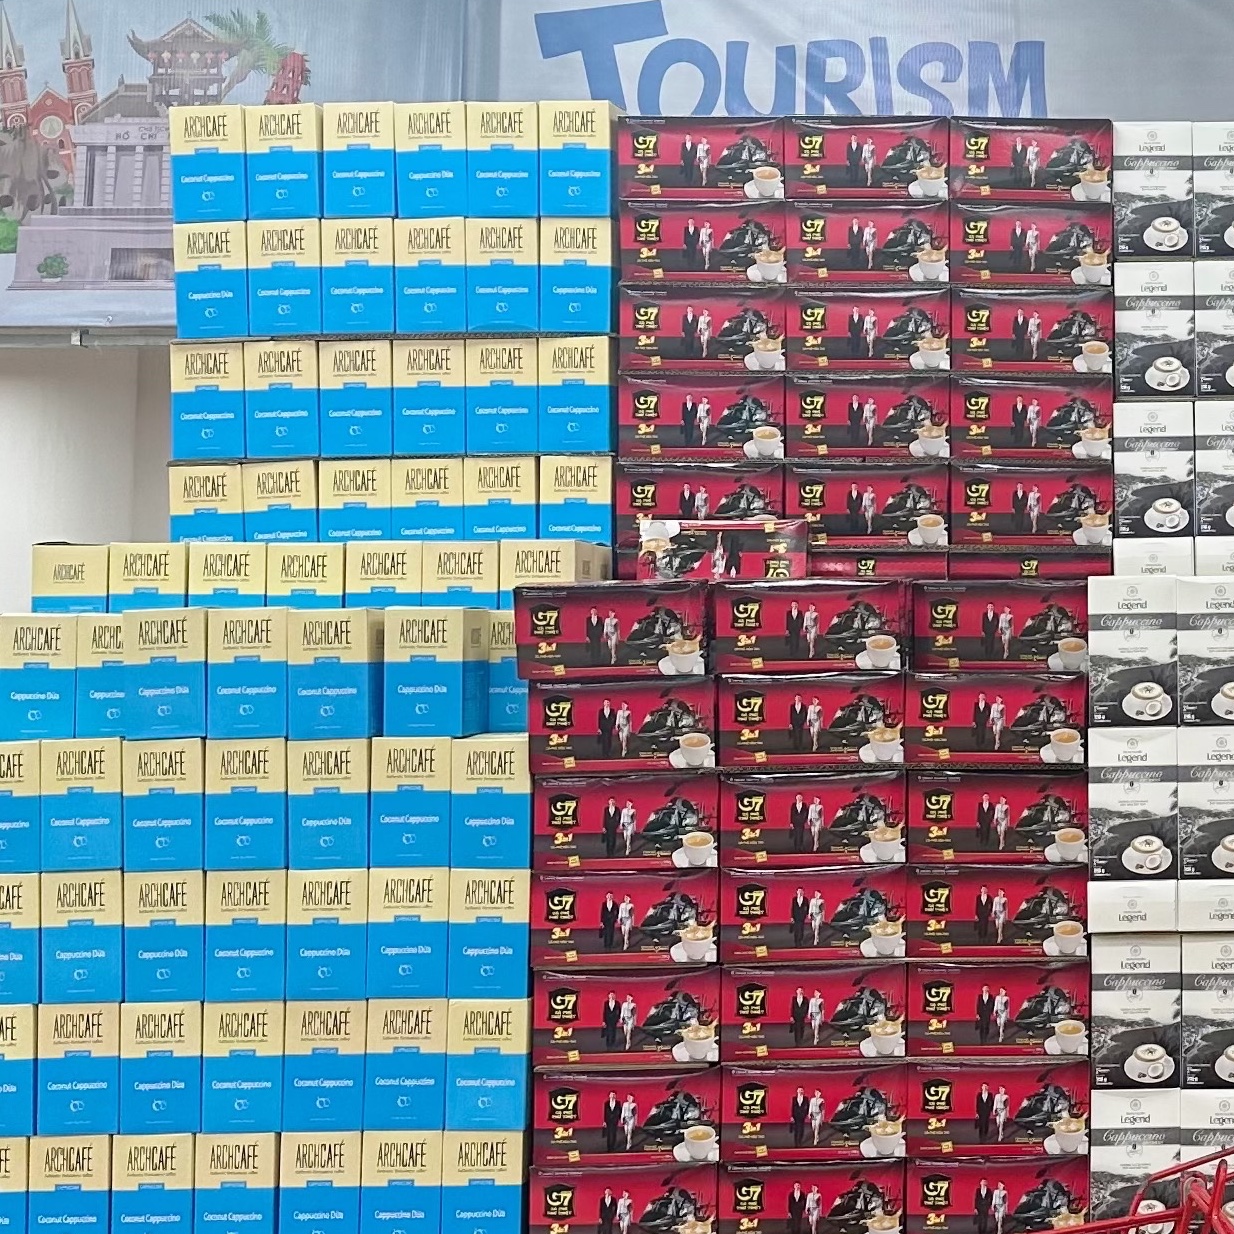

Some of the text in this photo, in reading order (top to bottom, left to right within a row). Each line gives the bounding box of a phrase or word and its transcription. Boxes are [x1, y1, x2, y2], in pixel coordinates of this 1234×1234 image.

[534, 1, 1045, 117] TOURISM
[183, 112, 229, 138] ARCHCAFÉ
[633, 134, 657, 149] G7
[800, 135, 822, 149] G7
[407, 224, 453, 250] ARCHCAFÉ
[965, 220, 987, 234] G7
[186, 228, 232, 254] ARCHCAFÉ
[802, 307, 824, 321] G7
[184, 349, 230, 375] ARCHCAFÉ
[634, 394, 658, 409] G7
[256, 468, 302, 494] ARCHCAFÉ
[477, 463, 523, 489] ARCHCAFÉ
[966, 482, 990, 497] G7
[123, 550, 171, 578] ARCHCAFÉ
[360, 549, 408, 577] ARCHCAFÉ
[734, 601, 760, 617] G7
[931, 603, 956, 619] G7
[1116, 600, 1149, 612] Legend
[138, 616, 189, 645] ARCHCAFÉ
[302, 617, 353, 646] ARCHCAFÉ
[400, 616, 448, 644] ARCHCAFÉ
[1100, 613, 1163, 630] Cappuccino
[546, 700, 572, 716] G7
[56, 747, 107, 776] ARCHCAFÉ
[466, 747, 517, 776] ARCHCAFÉ
[1116, 752, 1149, 764] Legend
[1100, 766, 1163, 783] Cappuccino
[551, 799, 577, 815] G7
[926, 793, 952, 809] G7
[56, 879, 107, 908] ARCHCAFÉ
[465, 876, 516, 905] ARCHCAFÉ
[739, 889, 765, 905] G7
[1117, 912, 1148, 923] Legend
[53, 1010, 104, 1039] ARCHCAFÉ
[301, 1007, 352, 1036] ARCHCAFÉ
[551, 1093, 577, 1109] G7
[925, 1084, 951, 1100] G7
[1119, 1114, 1152, 1126] Legend
[1103, 1128, 1166, 1145] Cappuccino
[44, 1144, 95, 1173] ARCHCAFÉ
[127, 1143, 178, 1172] ARCHCAFÉ
[377, 1139, 428, 1168] ARCHCAFÉ
